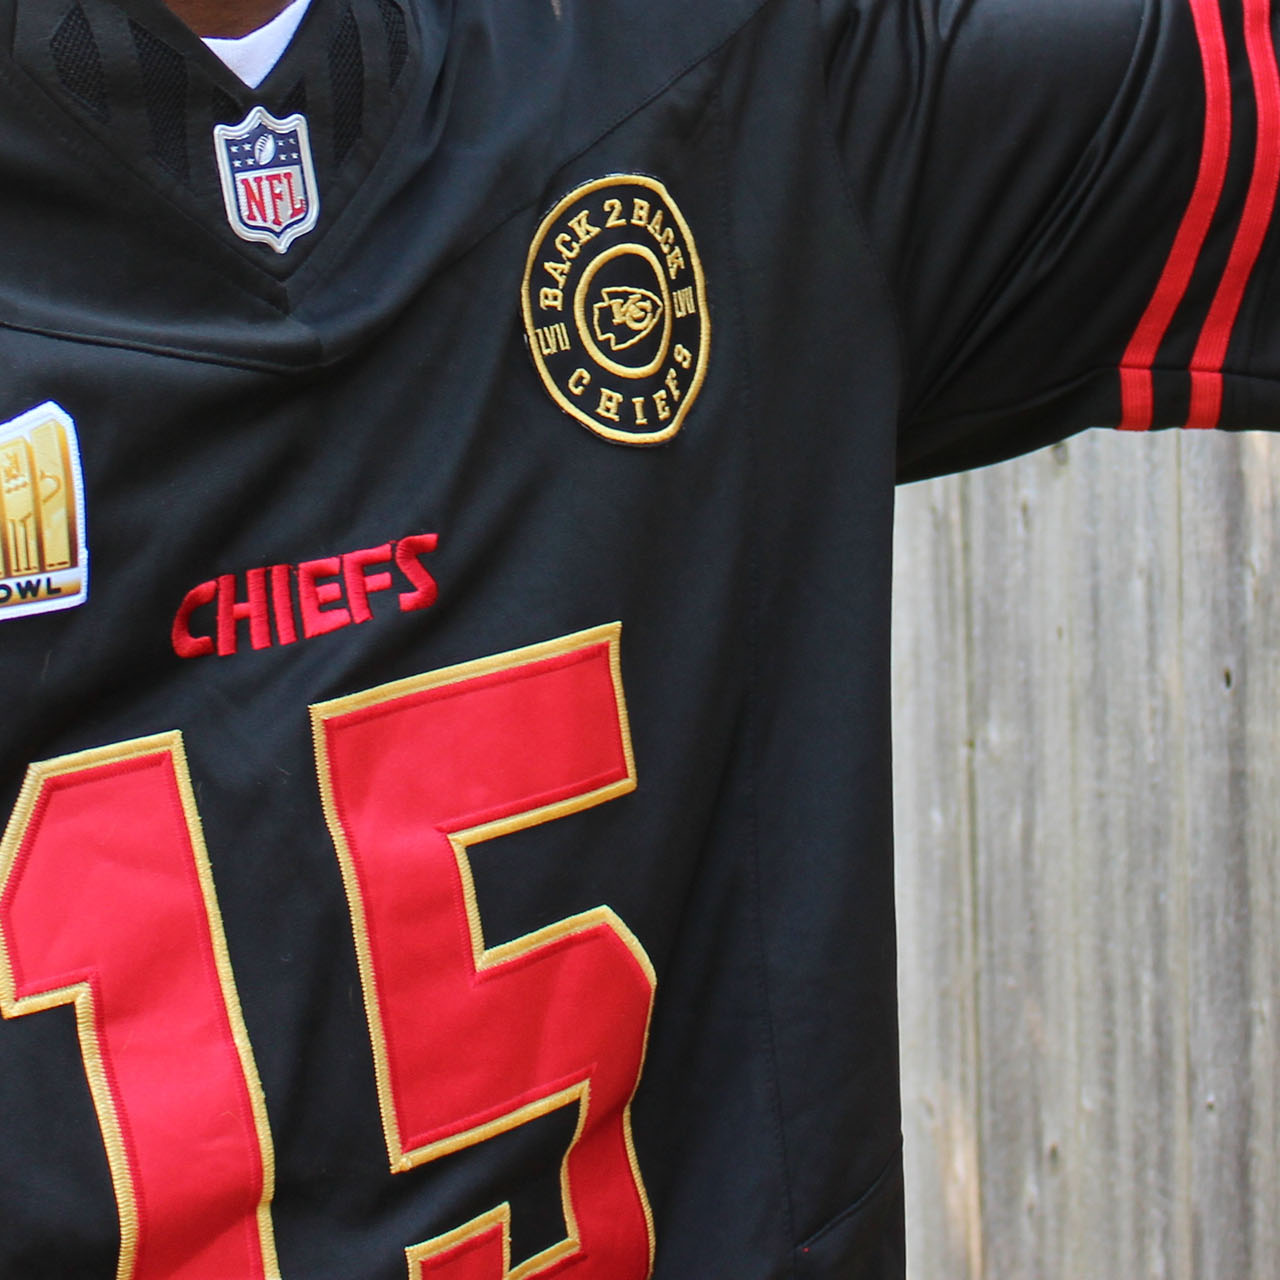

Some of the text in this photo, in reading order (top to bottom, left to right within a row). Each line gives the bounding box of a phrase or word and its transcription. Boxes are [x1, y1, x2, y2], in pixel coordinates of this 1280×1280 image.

[240, 172, 306, 226] NFL
[539, 198, 685, 312] BACK 2 BACK
[610, 294, 652, 331] KC
[568, 344, 692, 425] CHIEFS
[172, 533, 439, 658] CHIEFS
